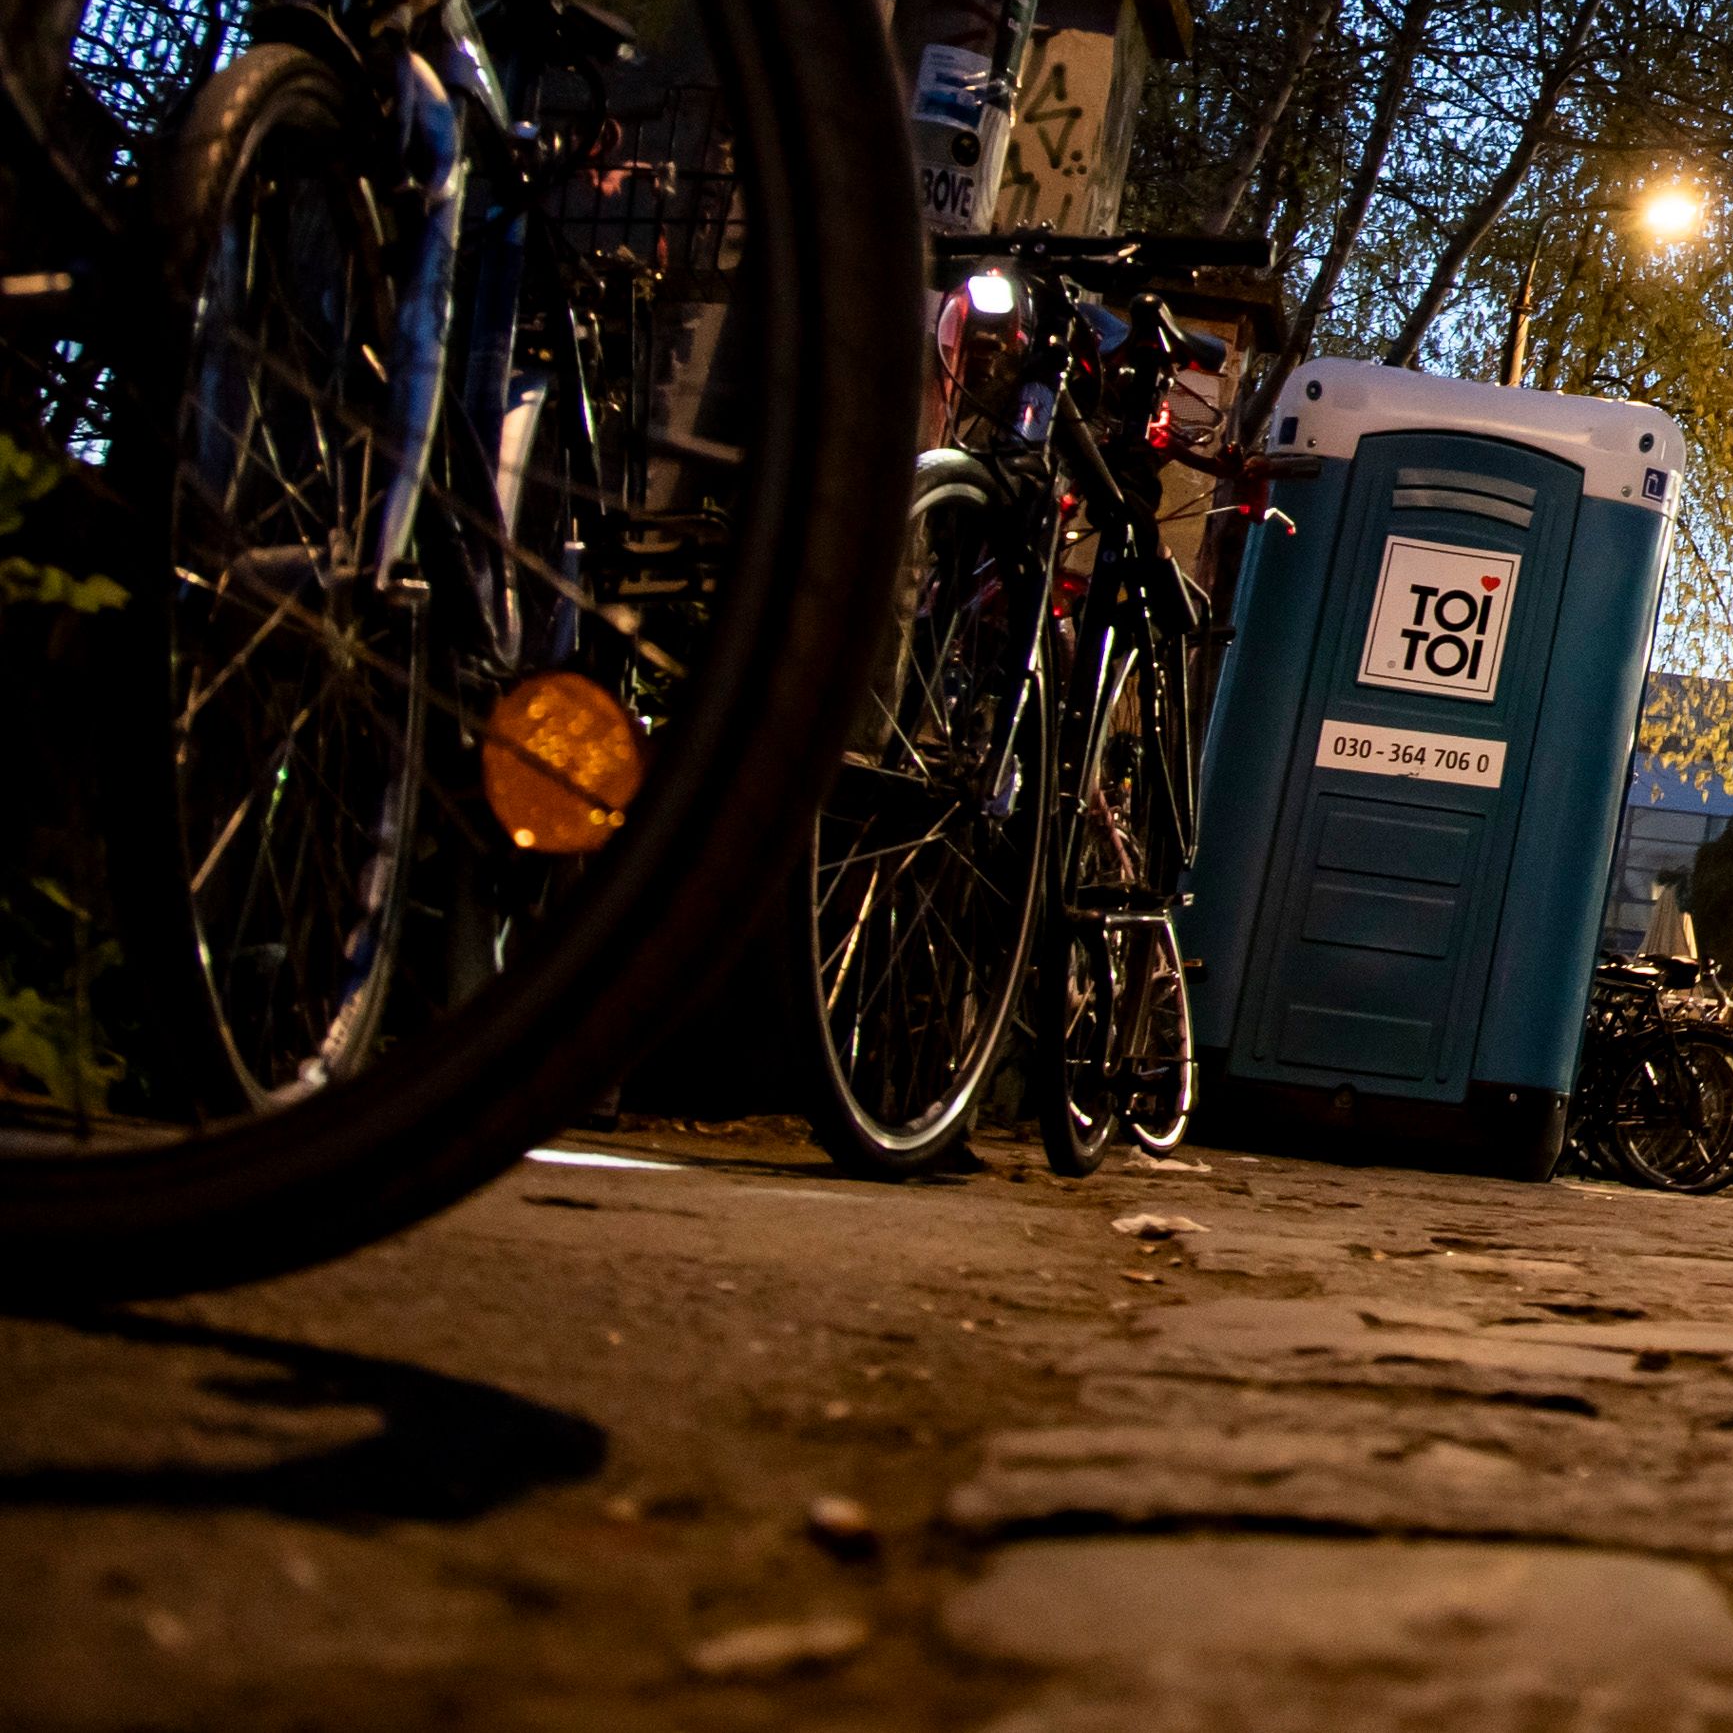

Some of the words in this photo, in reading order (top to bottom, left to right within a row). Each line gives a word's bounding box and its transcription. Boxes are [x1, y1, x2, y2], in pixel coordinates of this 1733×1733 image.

[1409, 584, 1494, 636] TOI
[1400, 629, 1485, 680] TOI
[1333, 735, 1371, 759] 030
[1388, 743, 1426, 766] 364
[1434, 748, 1470, 771] 706
[1476, 753, 1490, 774] 0
